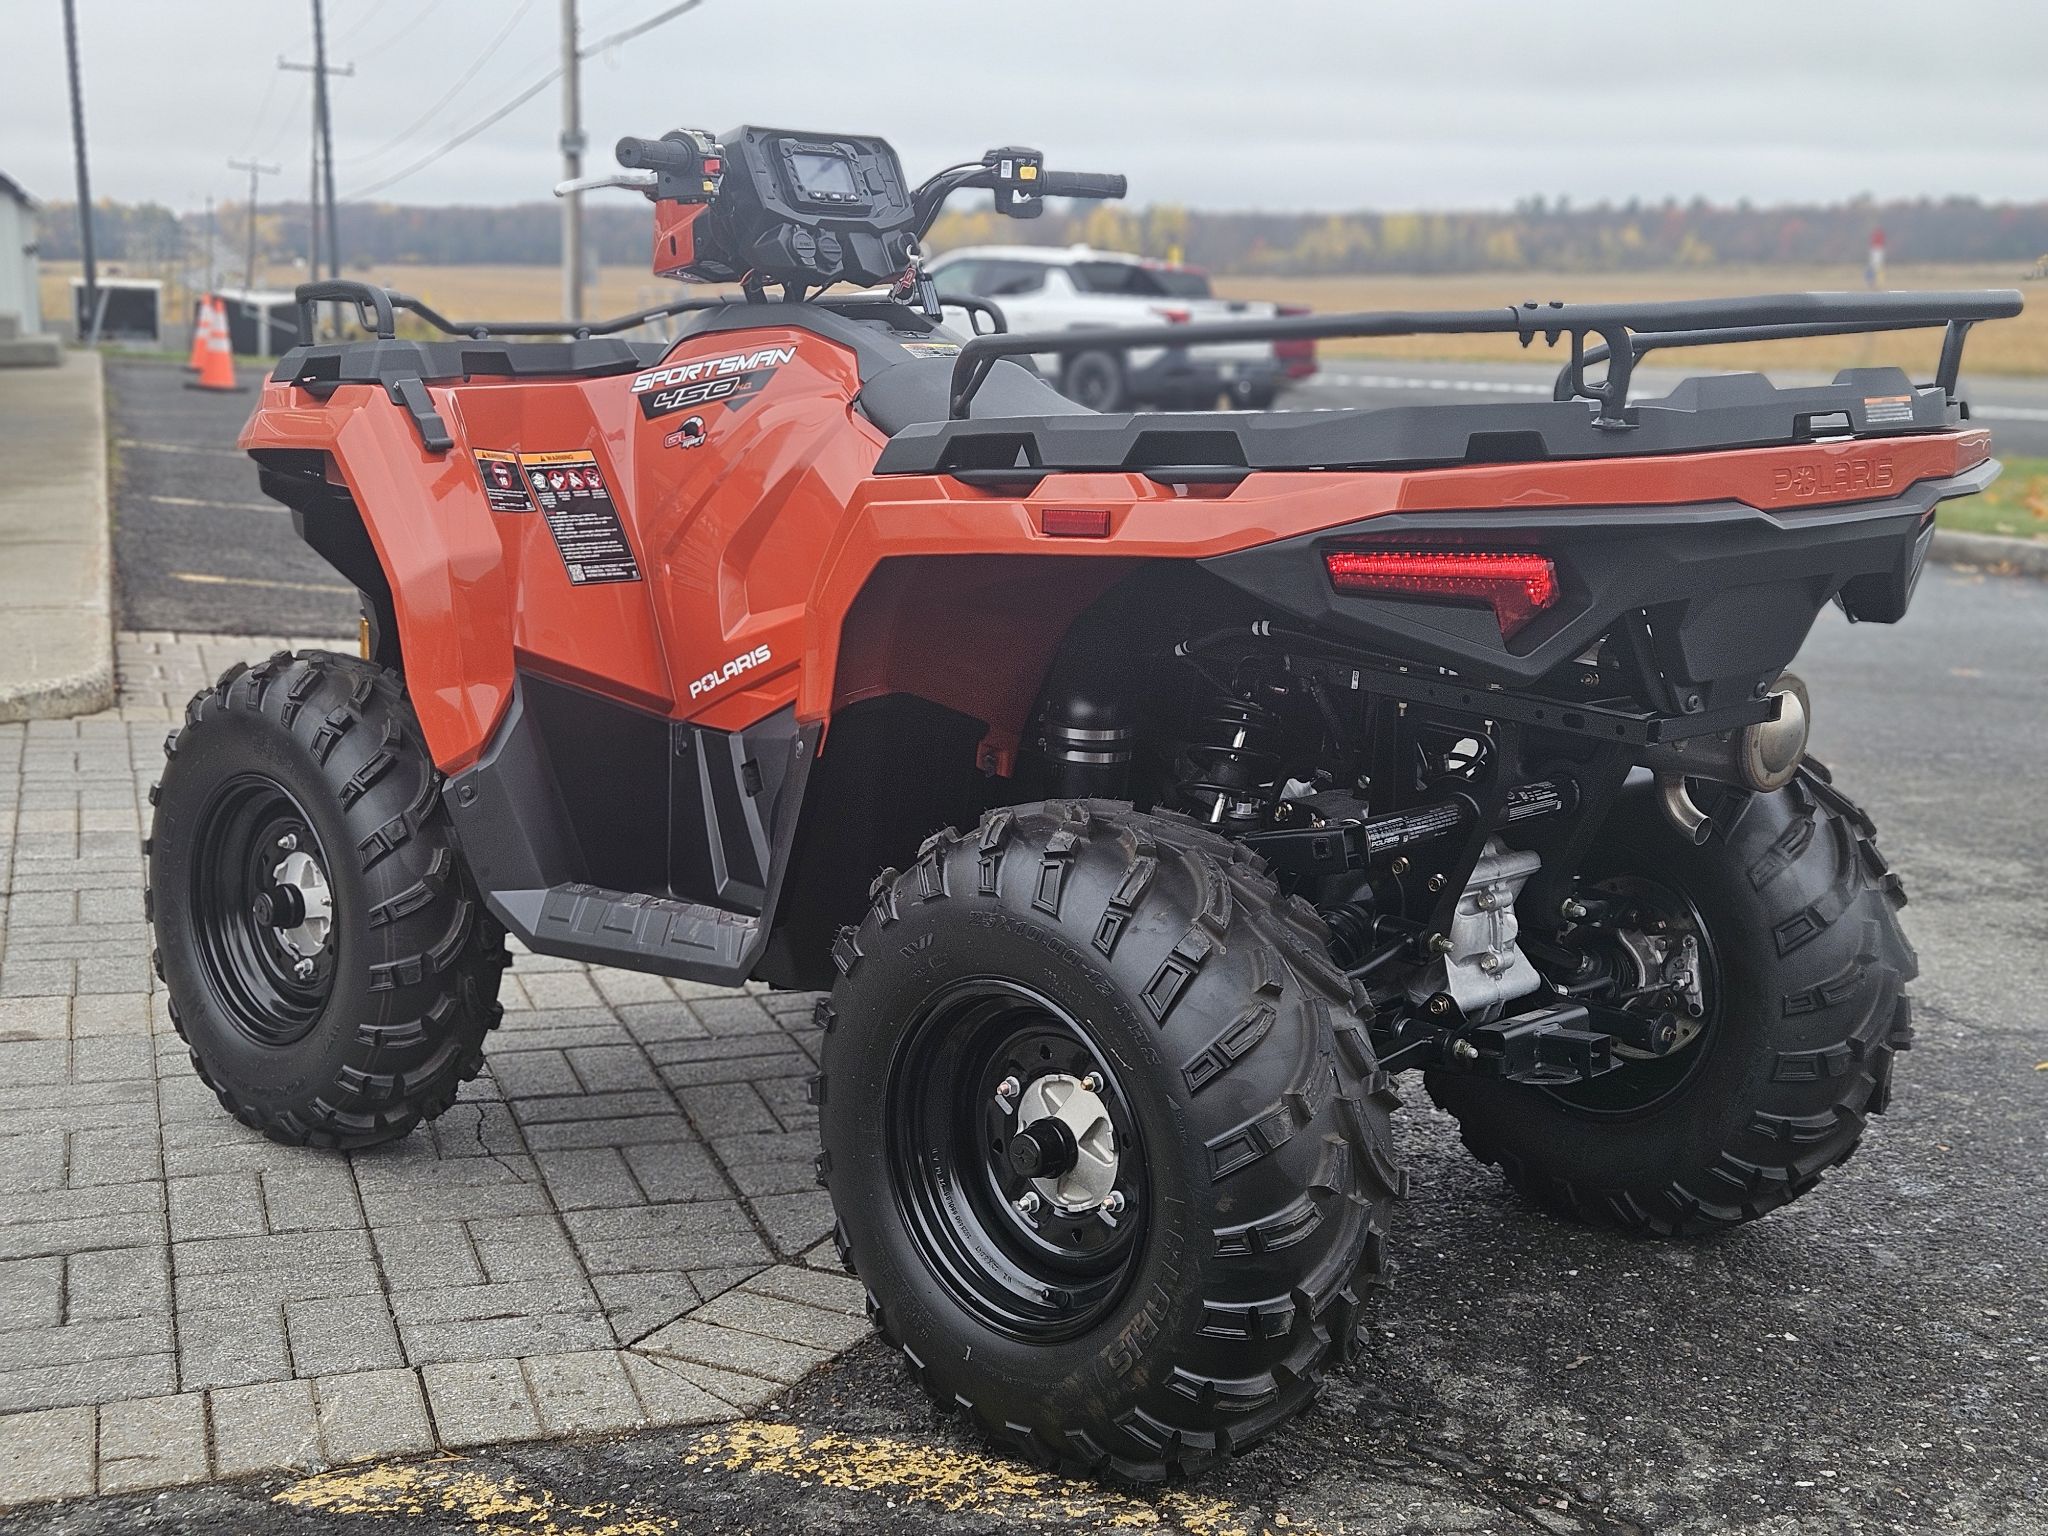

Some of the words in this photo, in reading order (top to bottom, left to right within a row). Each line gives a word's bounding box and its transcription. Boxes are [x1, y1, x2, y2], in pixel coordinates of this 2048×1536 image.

[631, 346, 797, 393] SPORTSMAN
[653, 376, 741, 409] 450
[499, 477, 508, 486] 16
[1771, 456, 1894, 499] POLARIS
[689, 644, 771, 699] POLARIS
[1371, 835, 1400, 848] POLARIS
